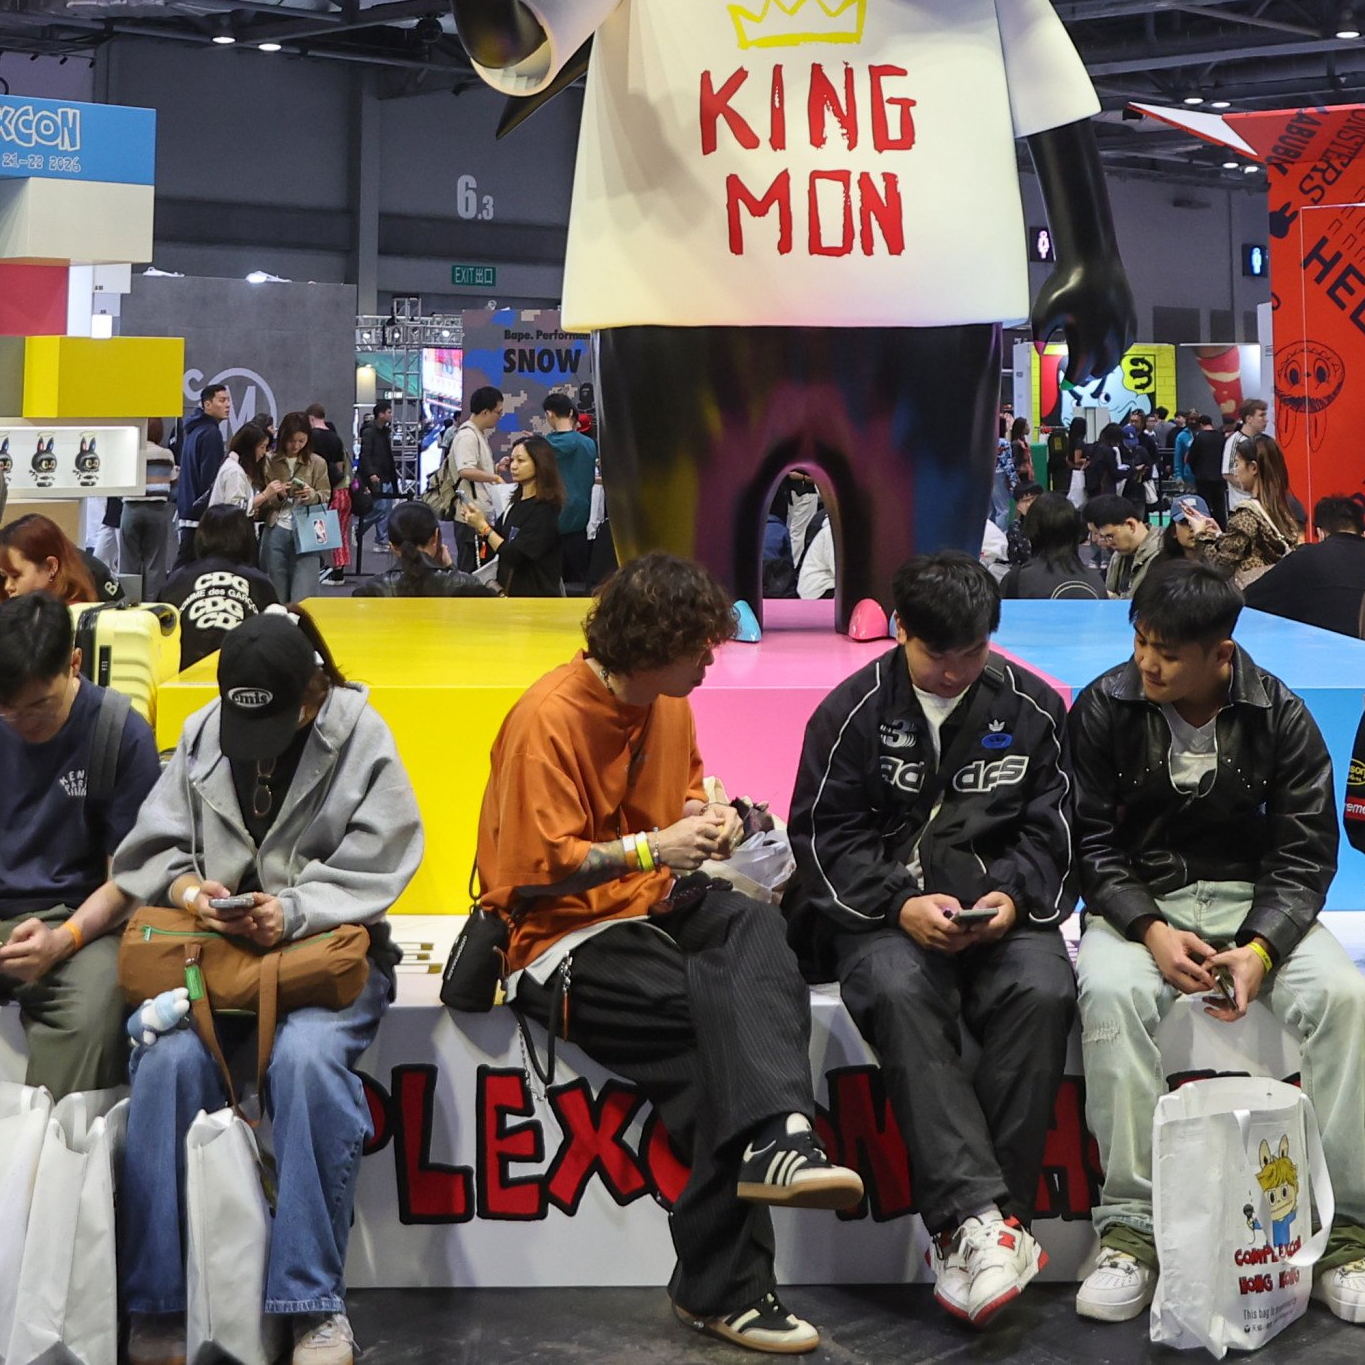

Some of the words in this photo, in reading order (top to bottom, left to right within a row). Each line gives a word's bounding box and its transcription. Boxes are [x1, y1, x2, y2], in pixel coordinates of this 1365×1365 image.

[699, 62, 917, 155] KING
[2, 152, 44, 170] 21-22
[49, 156, 81, 173] 2026
[456, 174, 495, 221] 6.3
[726, 168, 904, 256] MON
[455, 267, 475, 284] EXIT
[475, 267, 493, 284] 出口
[503, 348, 582, 374] SNOW
[195, 571, 249, 596] CDG
[189, 596, 244, 621] CDG
